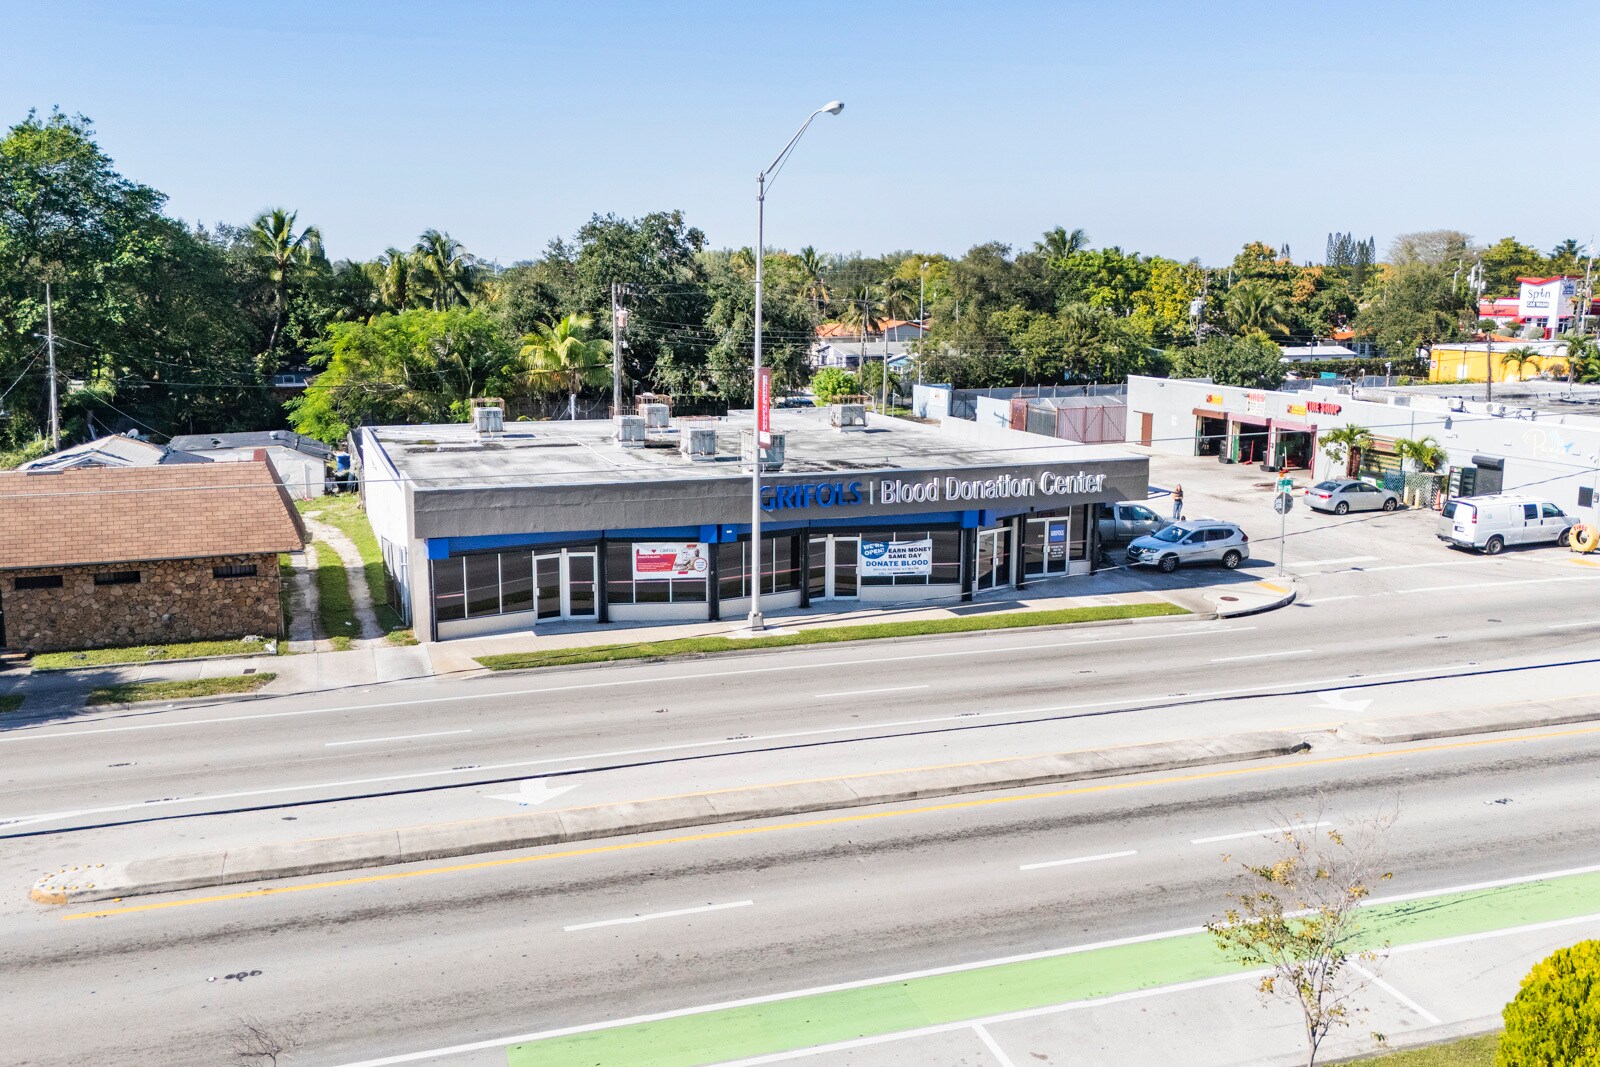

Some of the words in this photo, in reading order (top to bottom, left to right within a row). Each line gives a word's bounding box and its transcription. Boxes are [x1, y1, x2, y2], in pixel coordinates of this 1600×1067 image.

[1527, 288, 1551, 301] Spin
[1306, 401, 1320, 412] TIRE
[1321, 403, 1341, 415] SHOP
[760, 481, 863, 511] GRIFOLS
[881, 478, 940, 504] Blood
[946, 474, 1035, 500] Donation
[1040, 471, 1106, 495] Center
[864, 548, 885, 556] OPEN!
